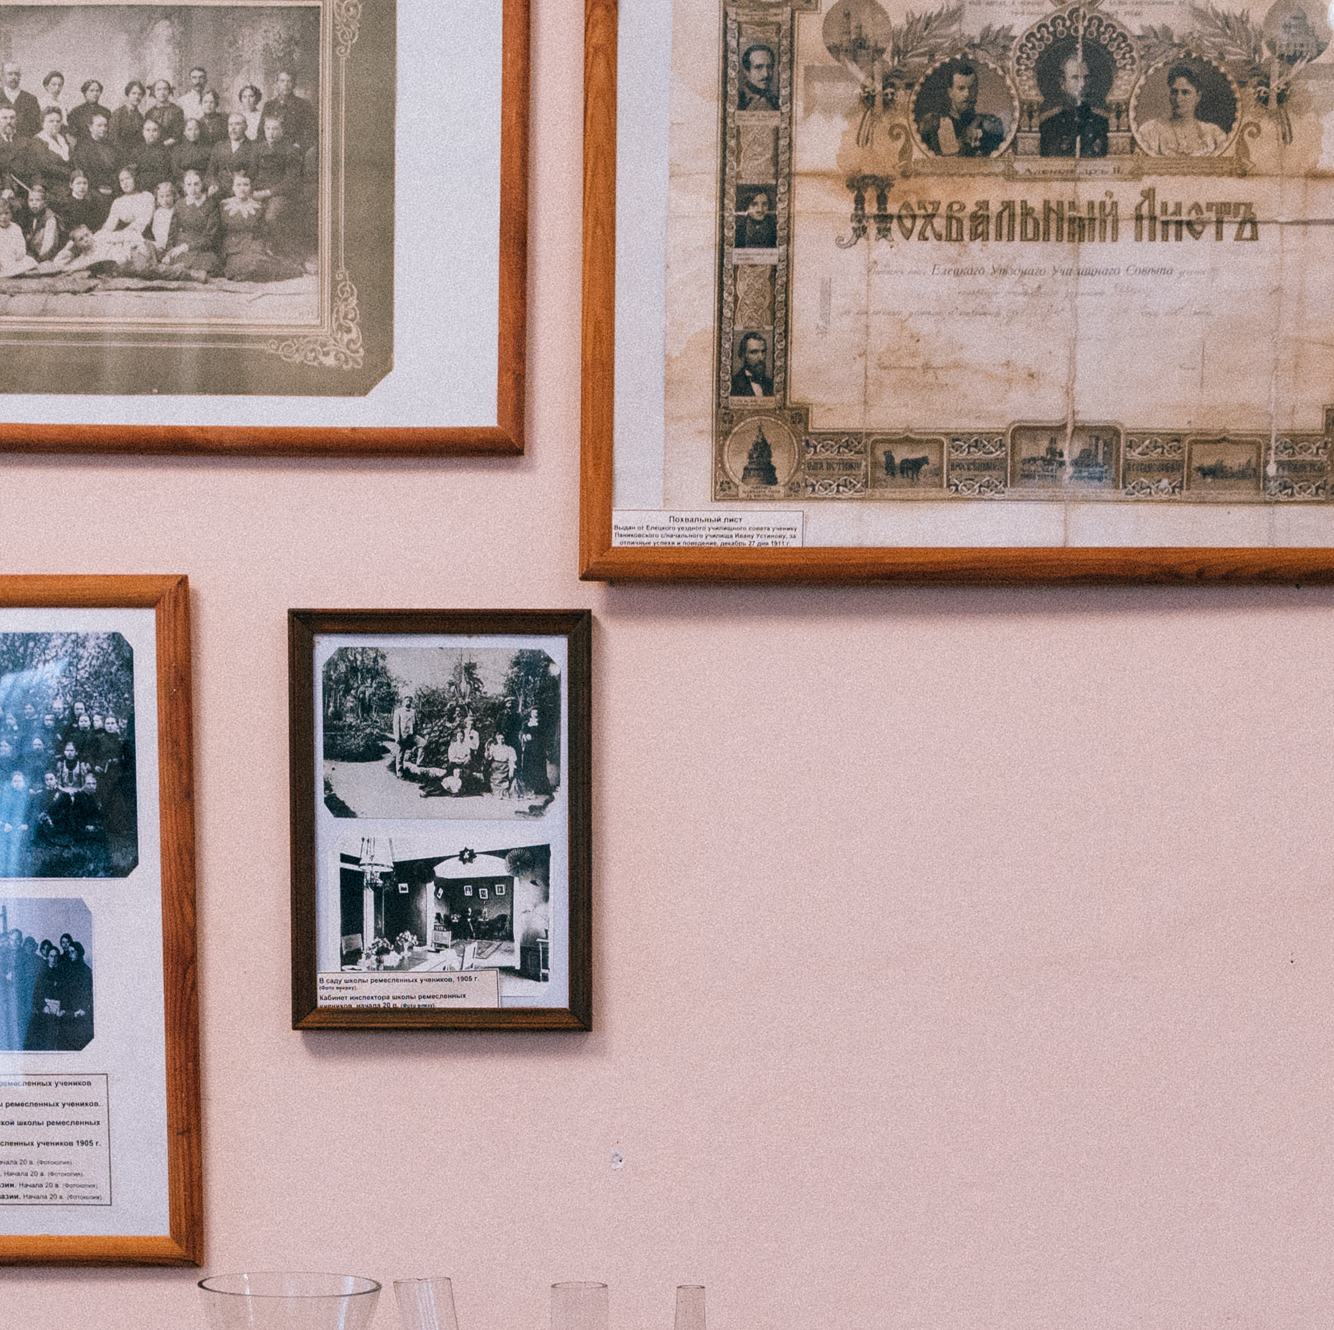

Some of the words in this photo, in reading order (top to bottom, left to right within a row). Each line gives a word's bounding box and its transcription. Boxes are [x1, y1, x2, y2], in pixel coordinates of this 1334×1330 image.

[1051, 264, 1120, 278] Учиищнаго
[370, 977, 418, 985] ремесленных
[418, 993, 467, 1001] ремесленных
[54, 1081, 92, 1089] учеников
[5, 1101, 59, 1109] ремесленных
[62, 1101, 101, 1109] учеников.
[46, 1120, 101, 1128] ремесленных
[36, 1140, 74, 1148] учеников
[76, 1139, 93, 1147] 1905
[3, 1170, 29, 1178] Начала
[18, 1181, 44, 1189] Начала
[45, 1181, 54, 1189] 20
[23, 1193, 48, 1201] Начала
[49, 1193, 58, 1201] 20
